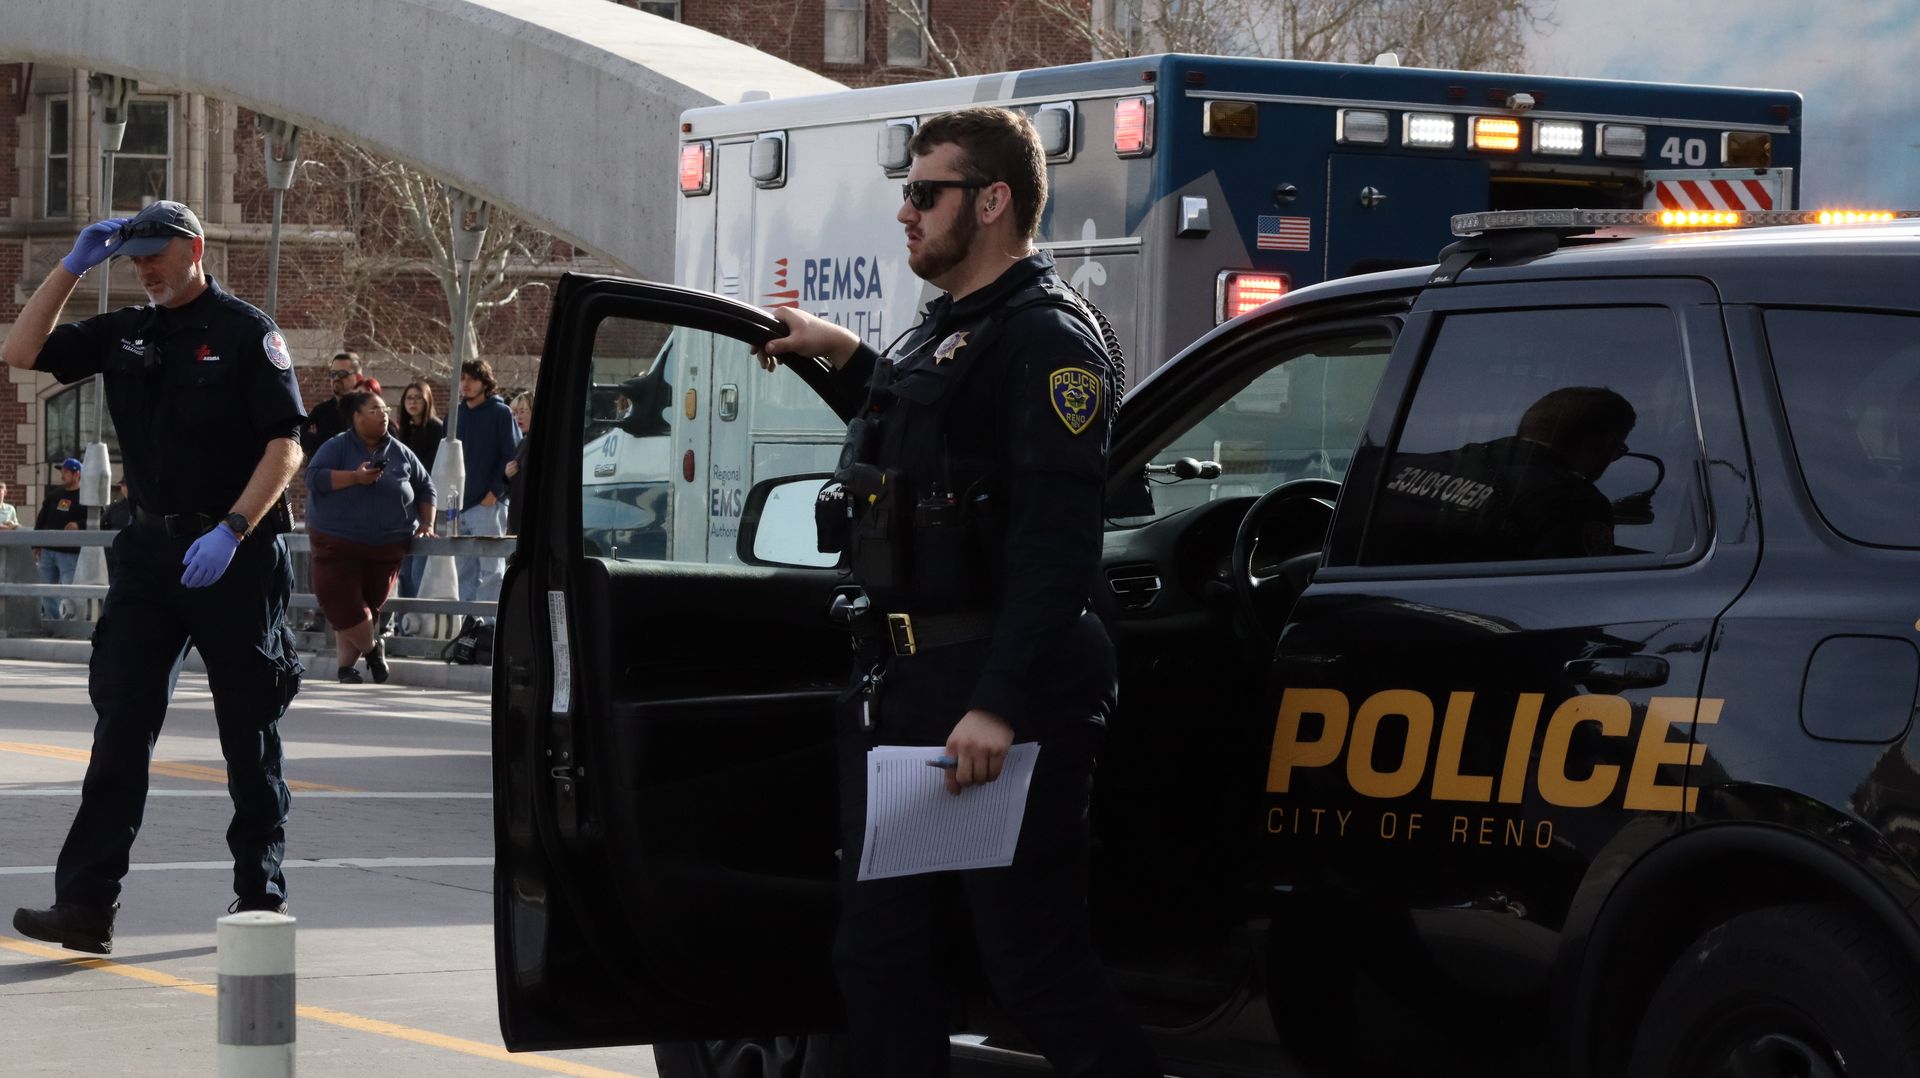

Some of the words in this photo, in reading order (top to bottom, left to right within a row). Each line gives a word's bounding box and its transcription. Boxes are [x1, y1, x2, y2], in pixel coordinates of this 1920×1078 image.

[1660, 136, 1707, 166] 40
[803, 255, 883, 301] REMSA
[812, 310, 883, 350] LTH
[1054, 372, 1096, 395] POLICE
[1066, 412, 1086, 423] RENO
[602, 434, 618, 458] 40
[713, 464, 741, 487] Regional
[711, 488, 742, 518] EMS
[1265, 687, 1725, 813] POLICE
[1267, 807, 1353, 837] CITY
[1380, 812, 1423, 840] OF
[1451, 815, 1553, 849] RENO
